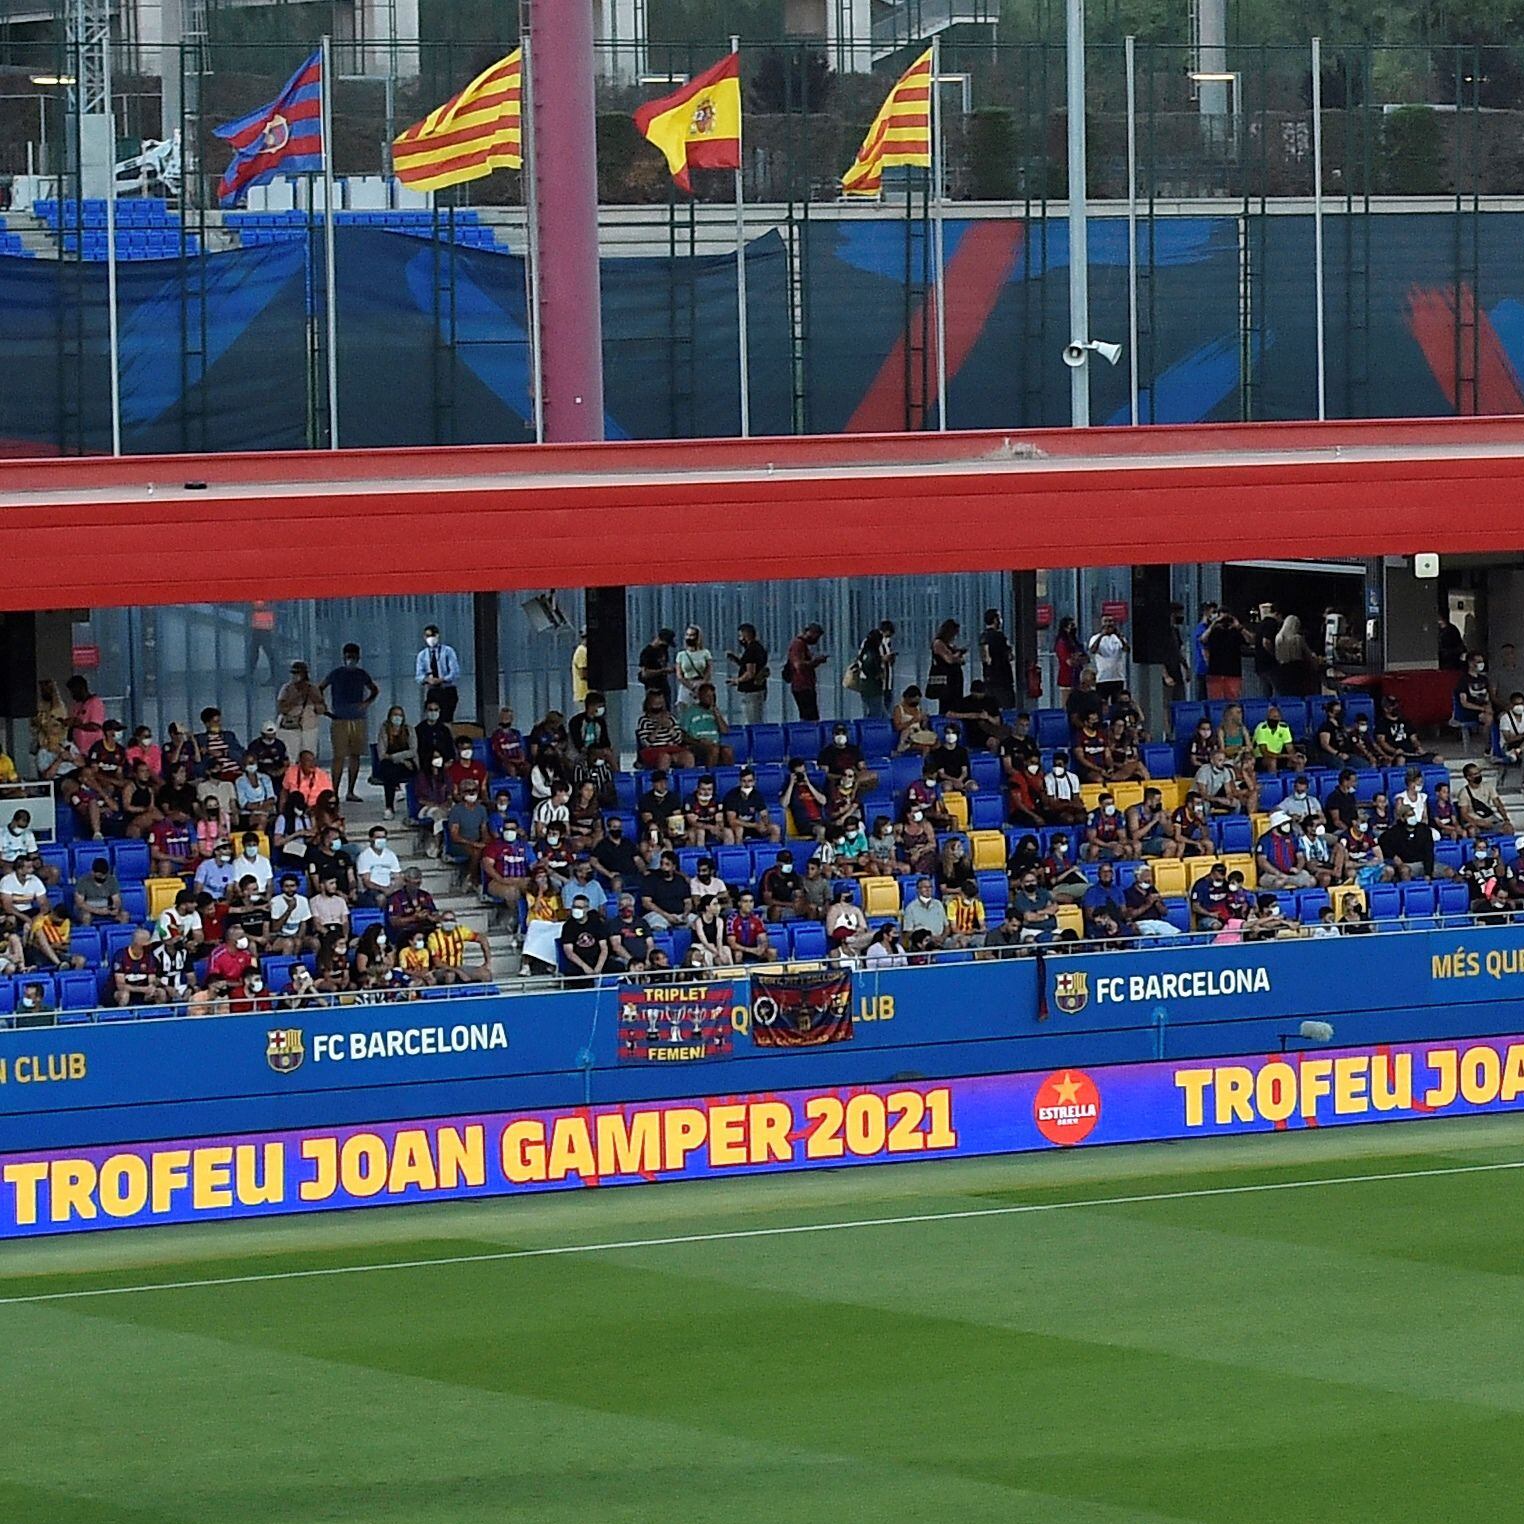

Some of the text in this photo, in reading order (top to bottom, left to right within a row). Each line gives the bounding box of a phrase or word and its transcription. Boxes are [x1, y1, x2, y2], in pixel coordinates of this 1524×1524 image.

[1432, 946, 1480, 979] MÉS
[643, 986, 708, 1003] TRIPLET
[1097, 967, 1271, 1004] FC BARCELONA
[313, 1022, 508, 1063] FC BARCELONA
[15, 1052, 87, 1083] CLUB
[1175, 1053, 1413, 1127] TROFEU
[1037, 1102, 1098, 1121] ESTRELLA
[2, 1087, 958, 1226] TROFEU JOAN GAMPER 2021
